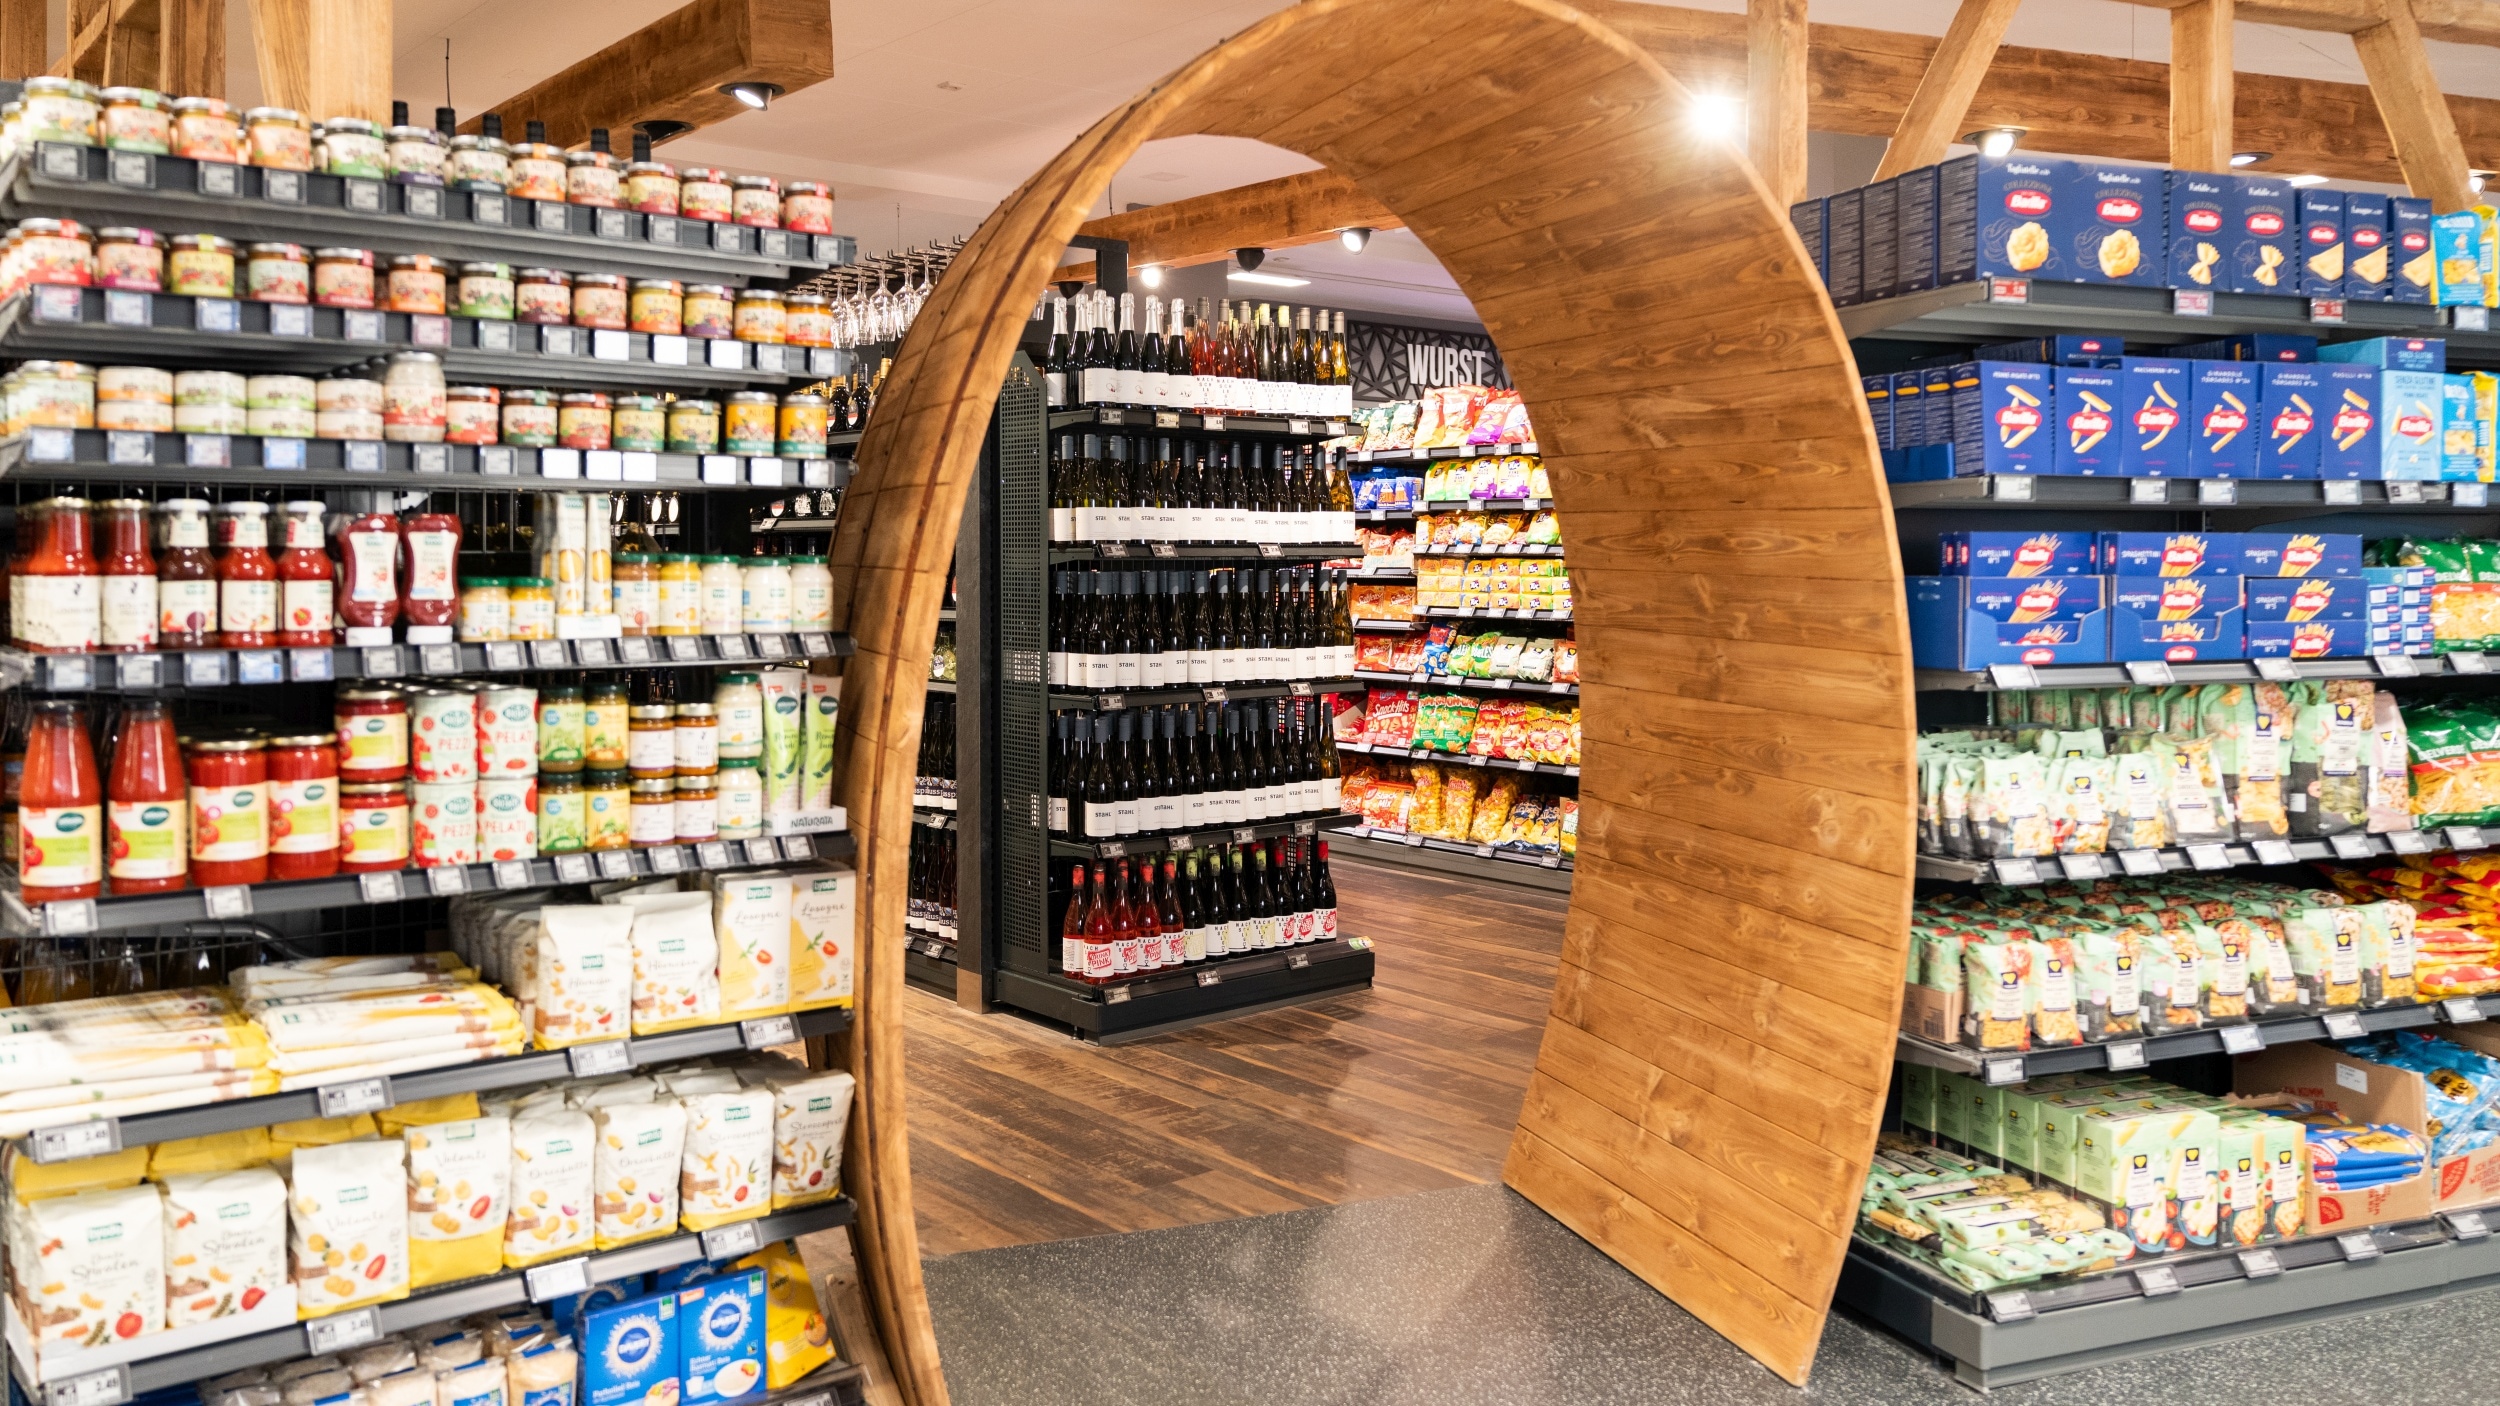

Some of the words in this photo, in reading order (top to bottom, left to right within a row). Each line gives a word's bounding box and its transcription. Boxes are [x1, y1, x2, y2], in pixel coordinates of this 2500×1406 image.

[1407, 344, 1486, 387] WURST
[2001, 411, 2038, 425] Barilla
[2072, 416, 2108, 430] Barilla
[2139, 412, 2176, 426] Barilla
[2209, 415, 2244, 428] Barilla
[2277, 418, 2311, 430] Barilla
[2337, 415, 2370, 428] Barilla
[2400, 420, 2431, 432] Barilla
[2018, 551, 2049, 562] Barilla
[2166, 551, 2198, 562] Barilla
[2286, 552, 2318, 563] Barilla
[2021, 595, 2054, 607] Barilla
[2164, 594, 2197, 606] Barilla
[2295, 597, 2327, 607] Barilla
[2295, 639, 2326, 650] Barilla
[2024, 652, 2053, 662] Barilla
[2168, 650, 2193, 659] Barilla
[791, 817, 833, 828] NATURATA
[813, 879, 837, 892] byodo
[747, 888, 772, 899] byodo
[659, 940, 685, 951] byodo
[808, 1096, 832, 1112] byodo
[724, 1106, 752, 1122] byodo
